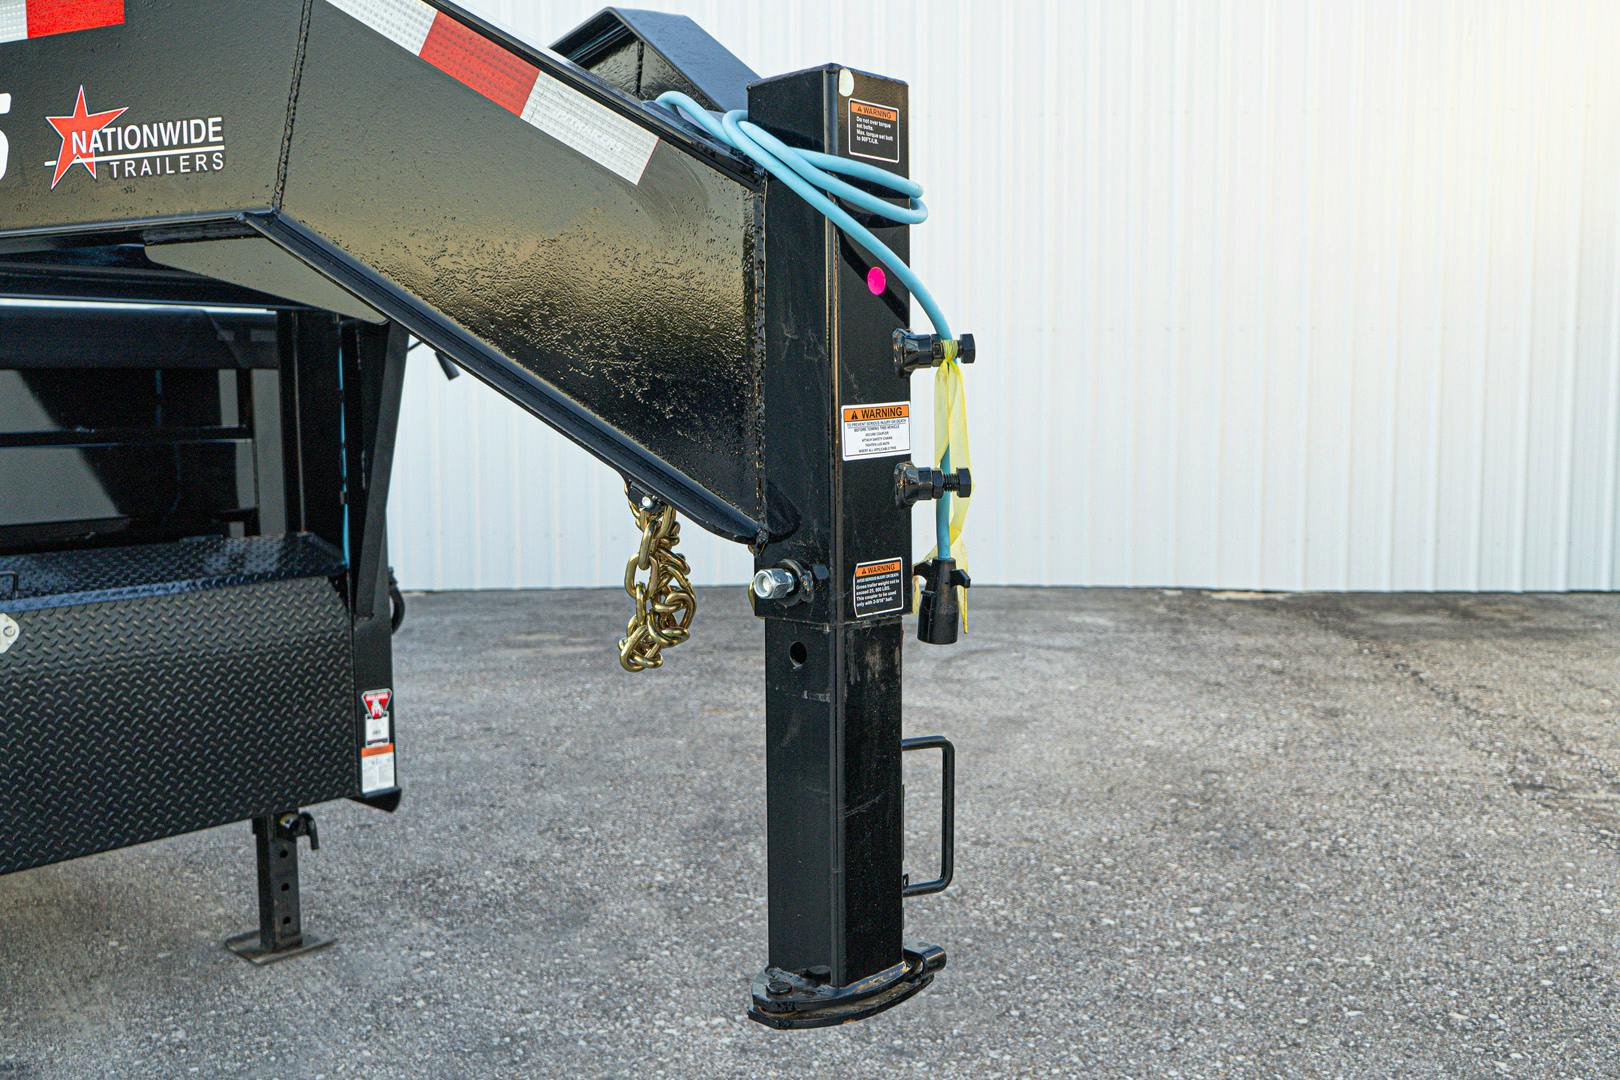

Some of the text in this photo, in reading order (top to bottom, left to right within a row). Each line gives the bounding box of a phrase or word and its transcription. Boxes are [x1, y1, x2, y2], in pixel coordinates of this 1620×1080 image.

[864, 107, 892, 118] WARNING
[71, 117, 224, 155] NATIONWIDE
[109, 152, 224, 179] TRAILERS
[861, 407, 902, 419] WARNING
[868, 564, 895, 574] WARNING
